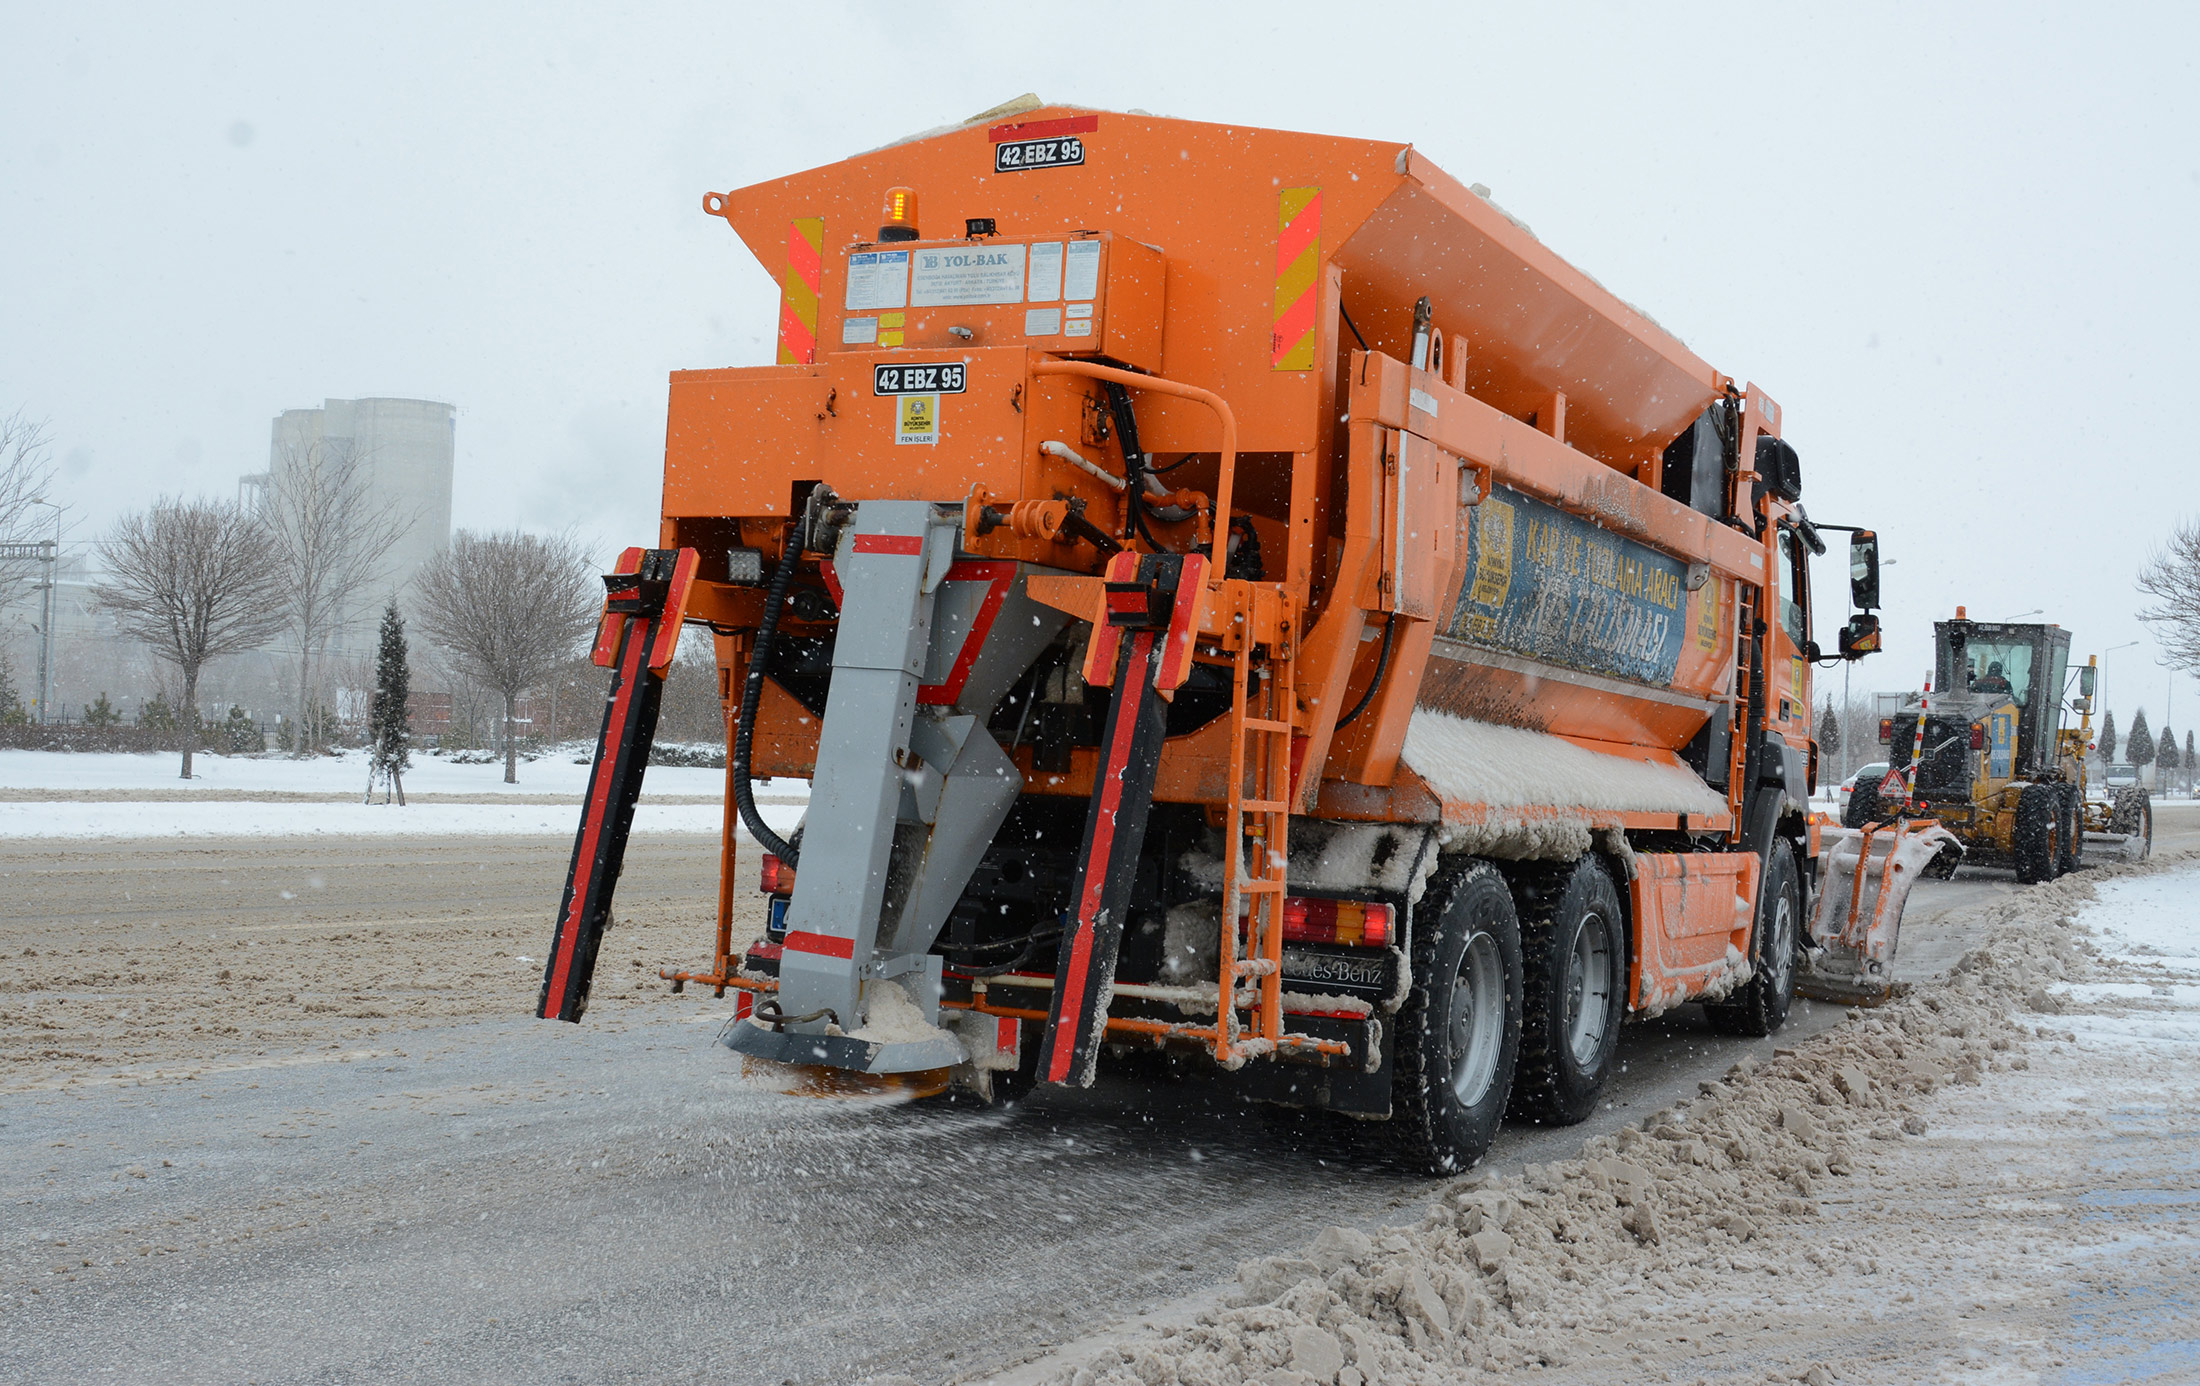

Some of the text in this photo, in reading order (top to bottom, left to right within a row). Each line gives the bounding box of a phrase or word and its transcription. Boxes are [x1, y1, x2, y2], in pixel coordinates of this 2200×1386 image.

[1001, 141, 1080, 165] 42 EBZ 95
[879, 367, 962, 389] 42 EBZ 95
[1585, 540, 1643, 600] TUZLAMA
[1645, 565, 1680, 612] ARACI
